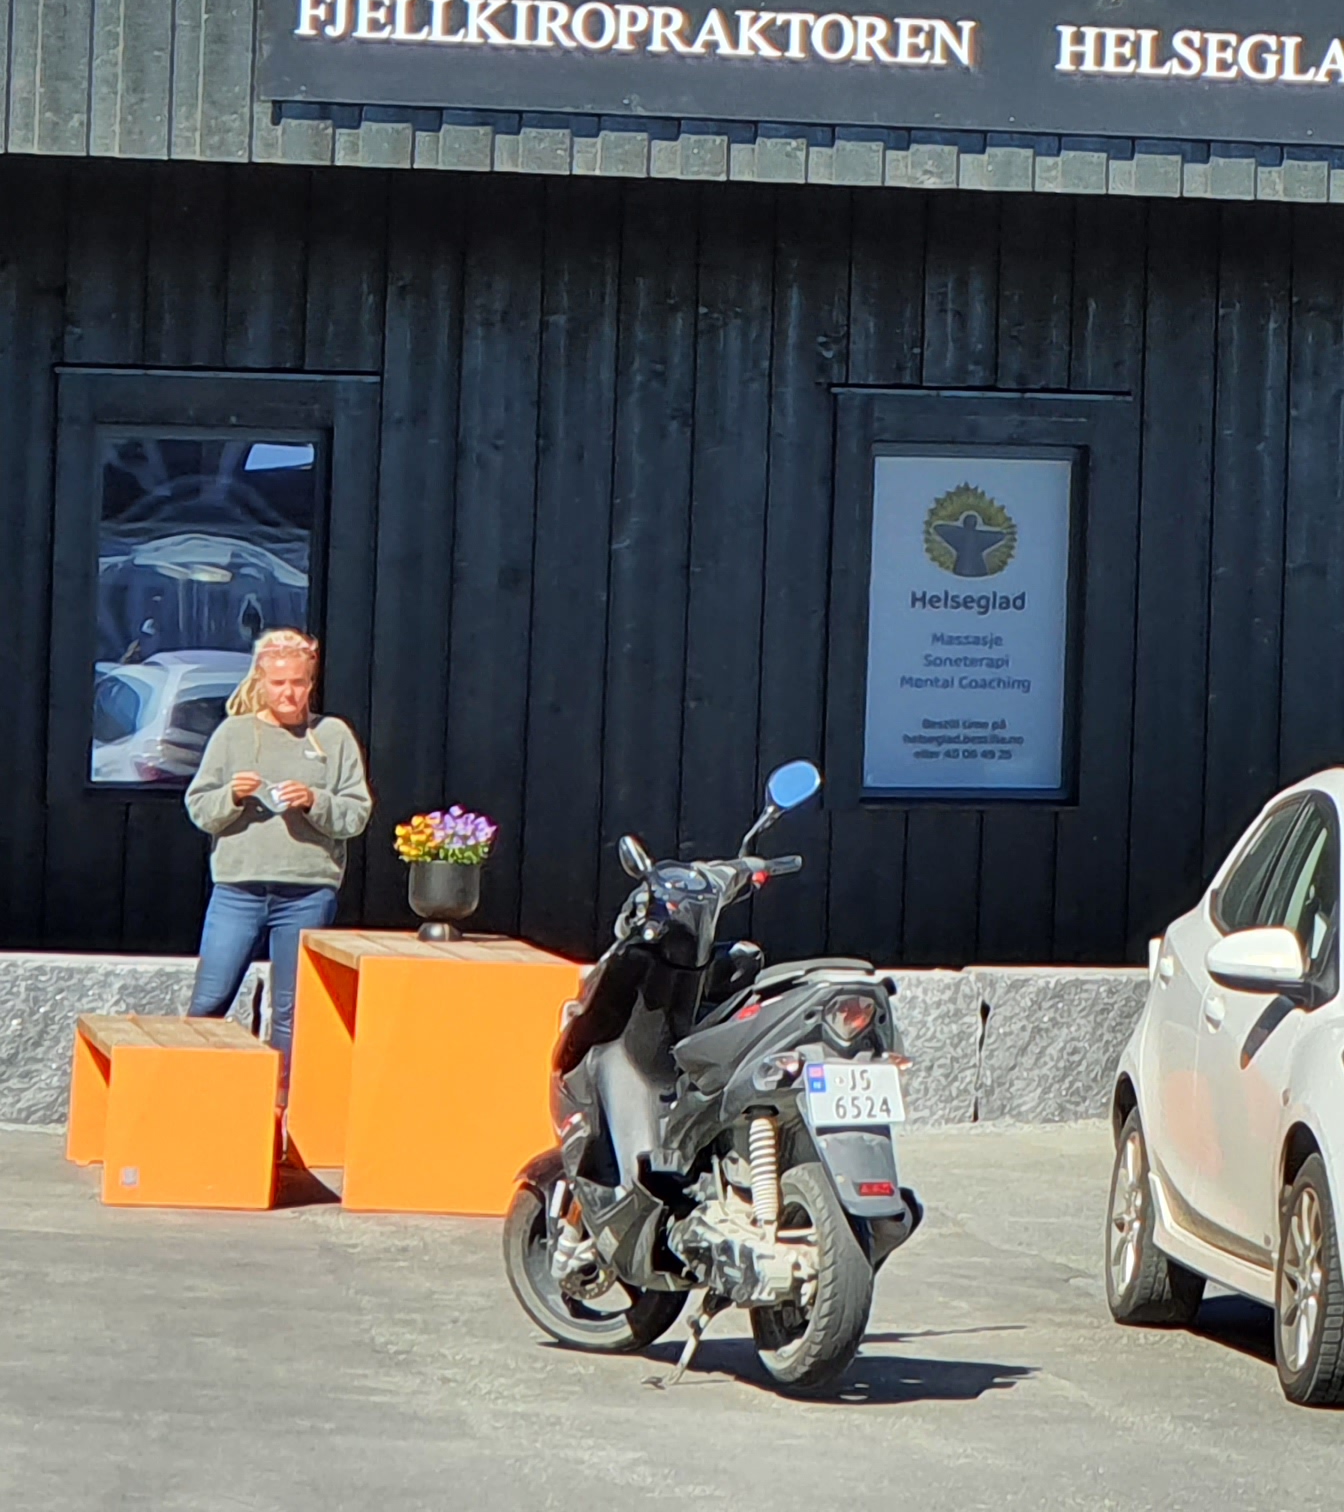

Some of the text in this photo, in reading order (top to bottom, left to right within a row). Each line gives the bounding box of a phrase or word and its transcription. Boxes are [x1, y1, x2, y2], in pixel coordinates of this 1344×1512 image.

[911, 590, 1026, 616] Helseglad
[931, 633, 1004, 649] Massasje
[923, 654, 1010, 669] Soneterapi
[900, 675, 1032, 694] Mental Coaching
[850, 1069, 872, 1092] JS
[835, 1096, 892, 1120] 6524
